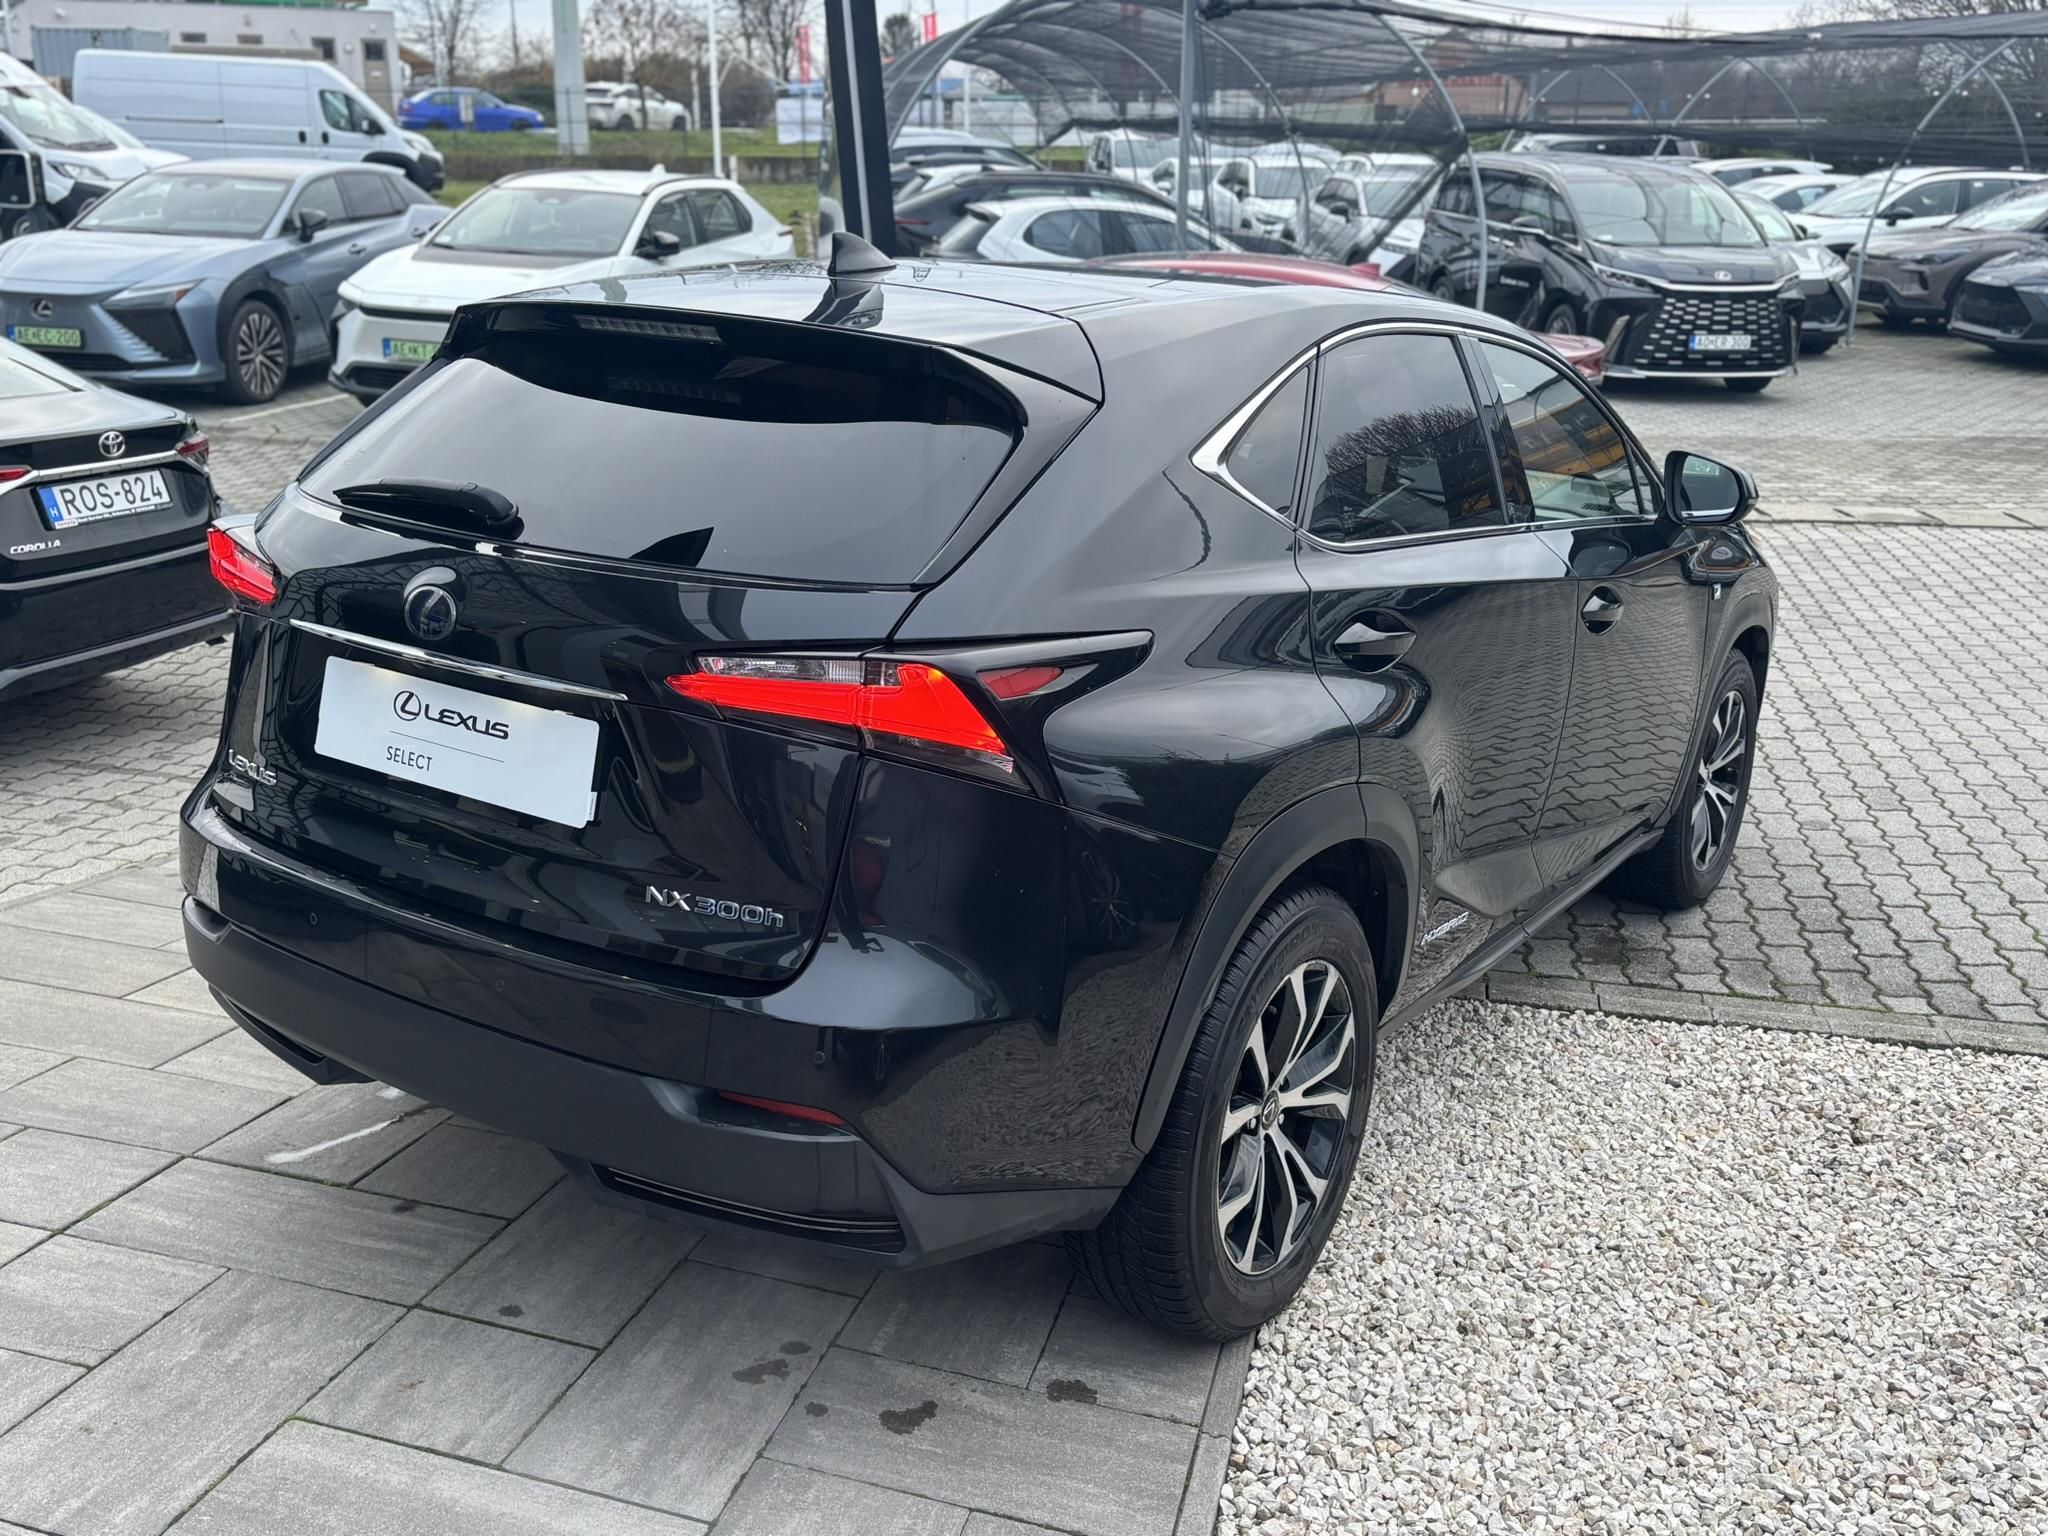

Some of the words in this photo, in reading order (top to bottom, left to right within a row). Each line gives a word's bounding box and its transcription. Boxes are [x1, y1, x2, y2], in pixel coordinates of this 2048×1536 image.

[59, 474, 163, 516] ROS-824
[51, 507, 59, 517] H
[10, 539, 61, 554] COROLLA
[424, 703, 510, 741] LEXUS
[228, 748, 277, 786] LEXUS
[386, 745, 433, 772] SELECT
